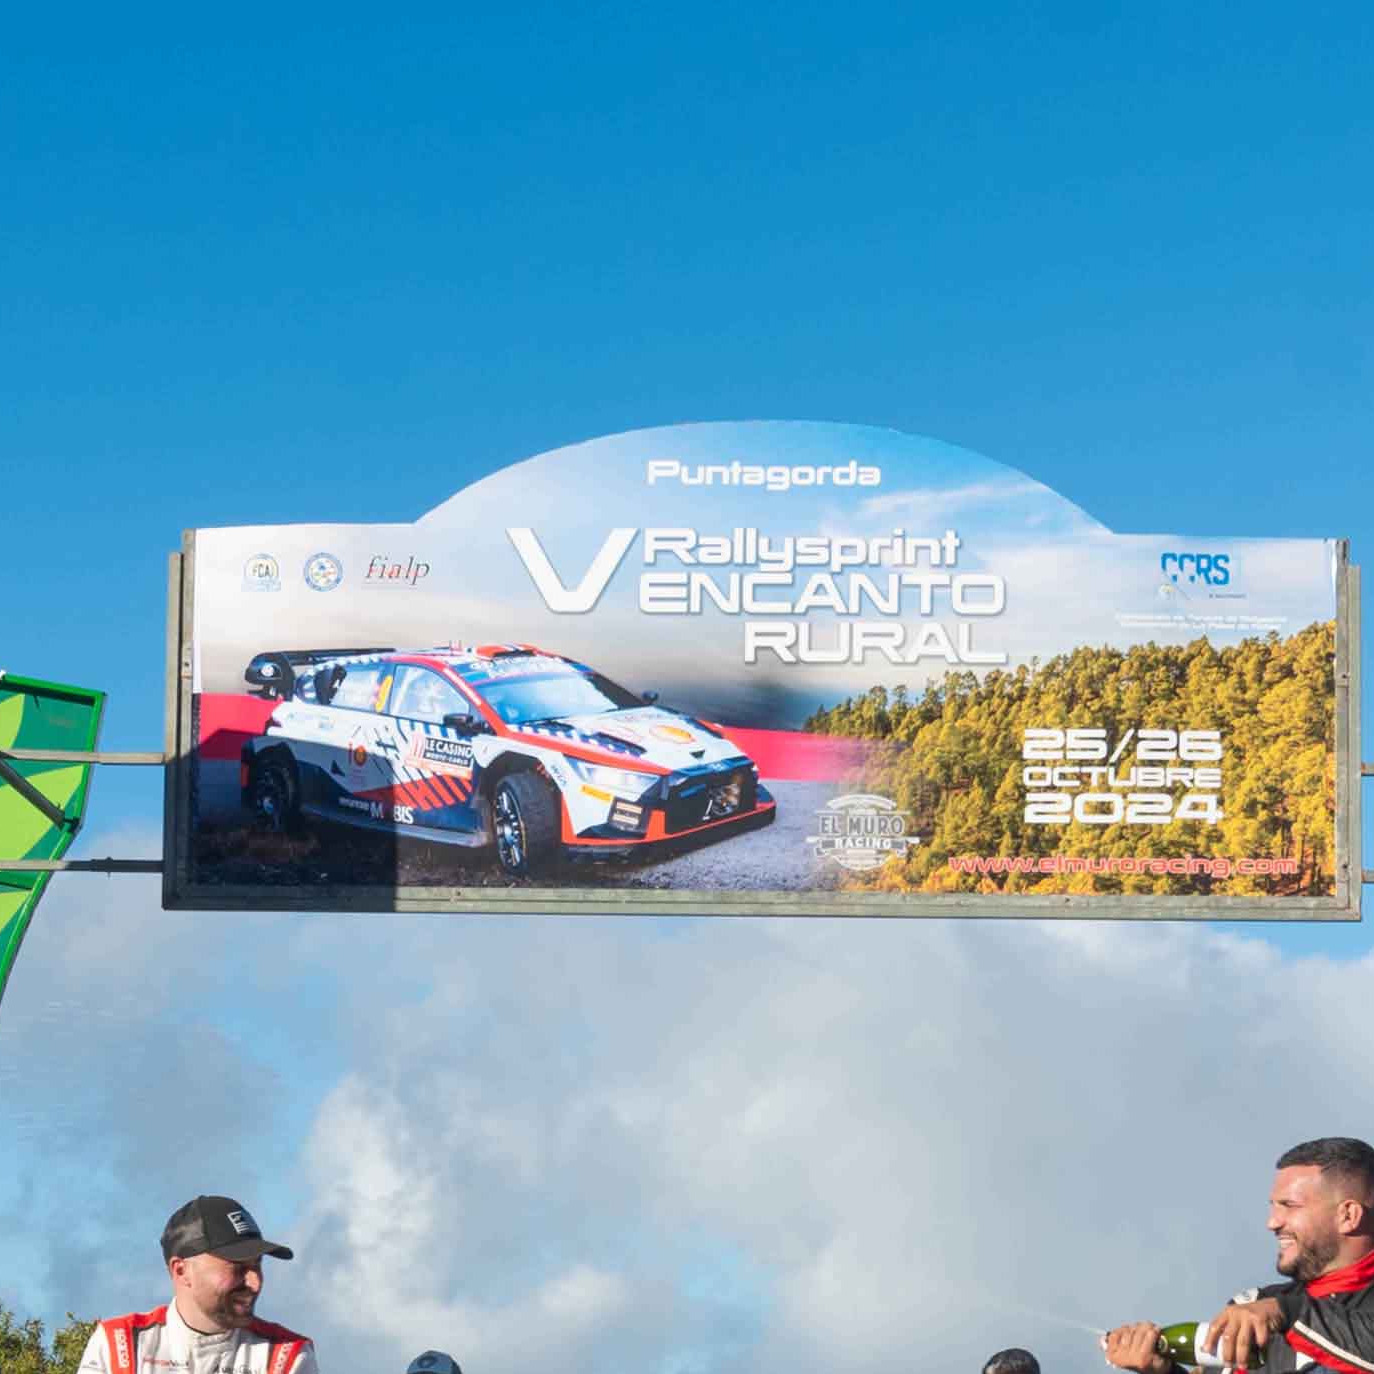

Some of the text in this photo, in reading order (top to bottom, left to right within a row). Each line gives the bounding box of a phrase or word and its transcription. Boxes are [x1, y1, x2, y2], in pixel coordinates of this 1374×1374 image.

[647, 460, 881, 491] Puntagorda
[643, 527, 961, 573] Rallysprint
[506, 527, 639, 615] V
[1161, 552, 1230, 585] CCRS
[638, 573, 1007, 616] ENCANTO
[744, 622, 1009, 665] RURAL
[1023, 728, 1224, 764] 25/26
[1023, 766, 1224, 788] OCTUBRE
[848, 816, 905, 835] MURO
[1024, 793, 1225, 826] 2024
[948, 856, 1297, 878] www.elmuroracing.com
